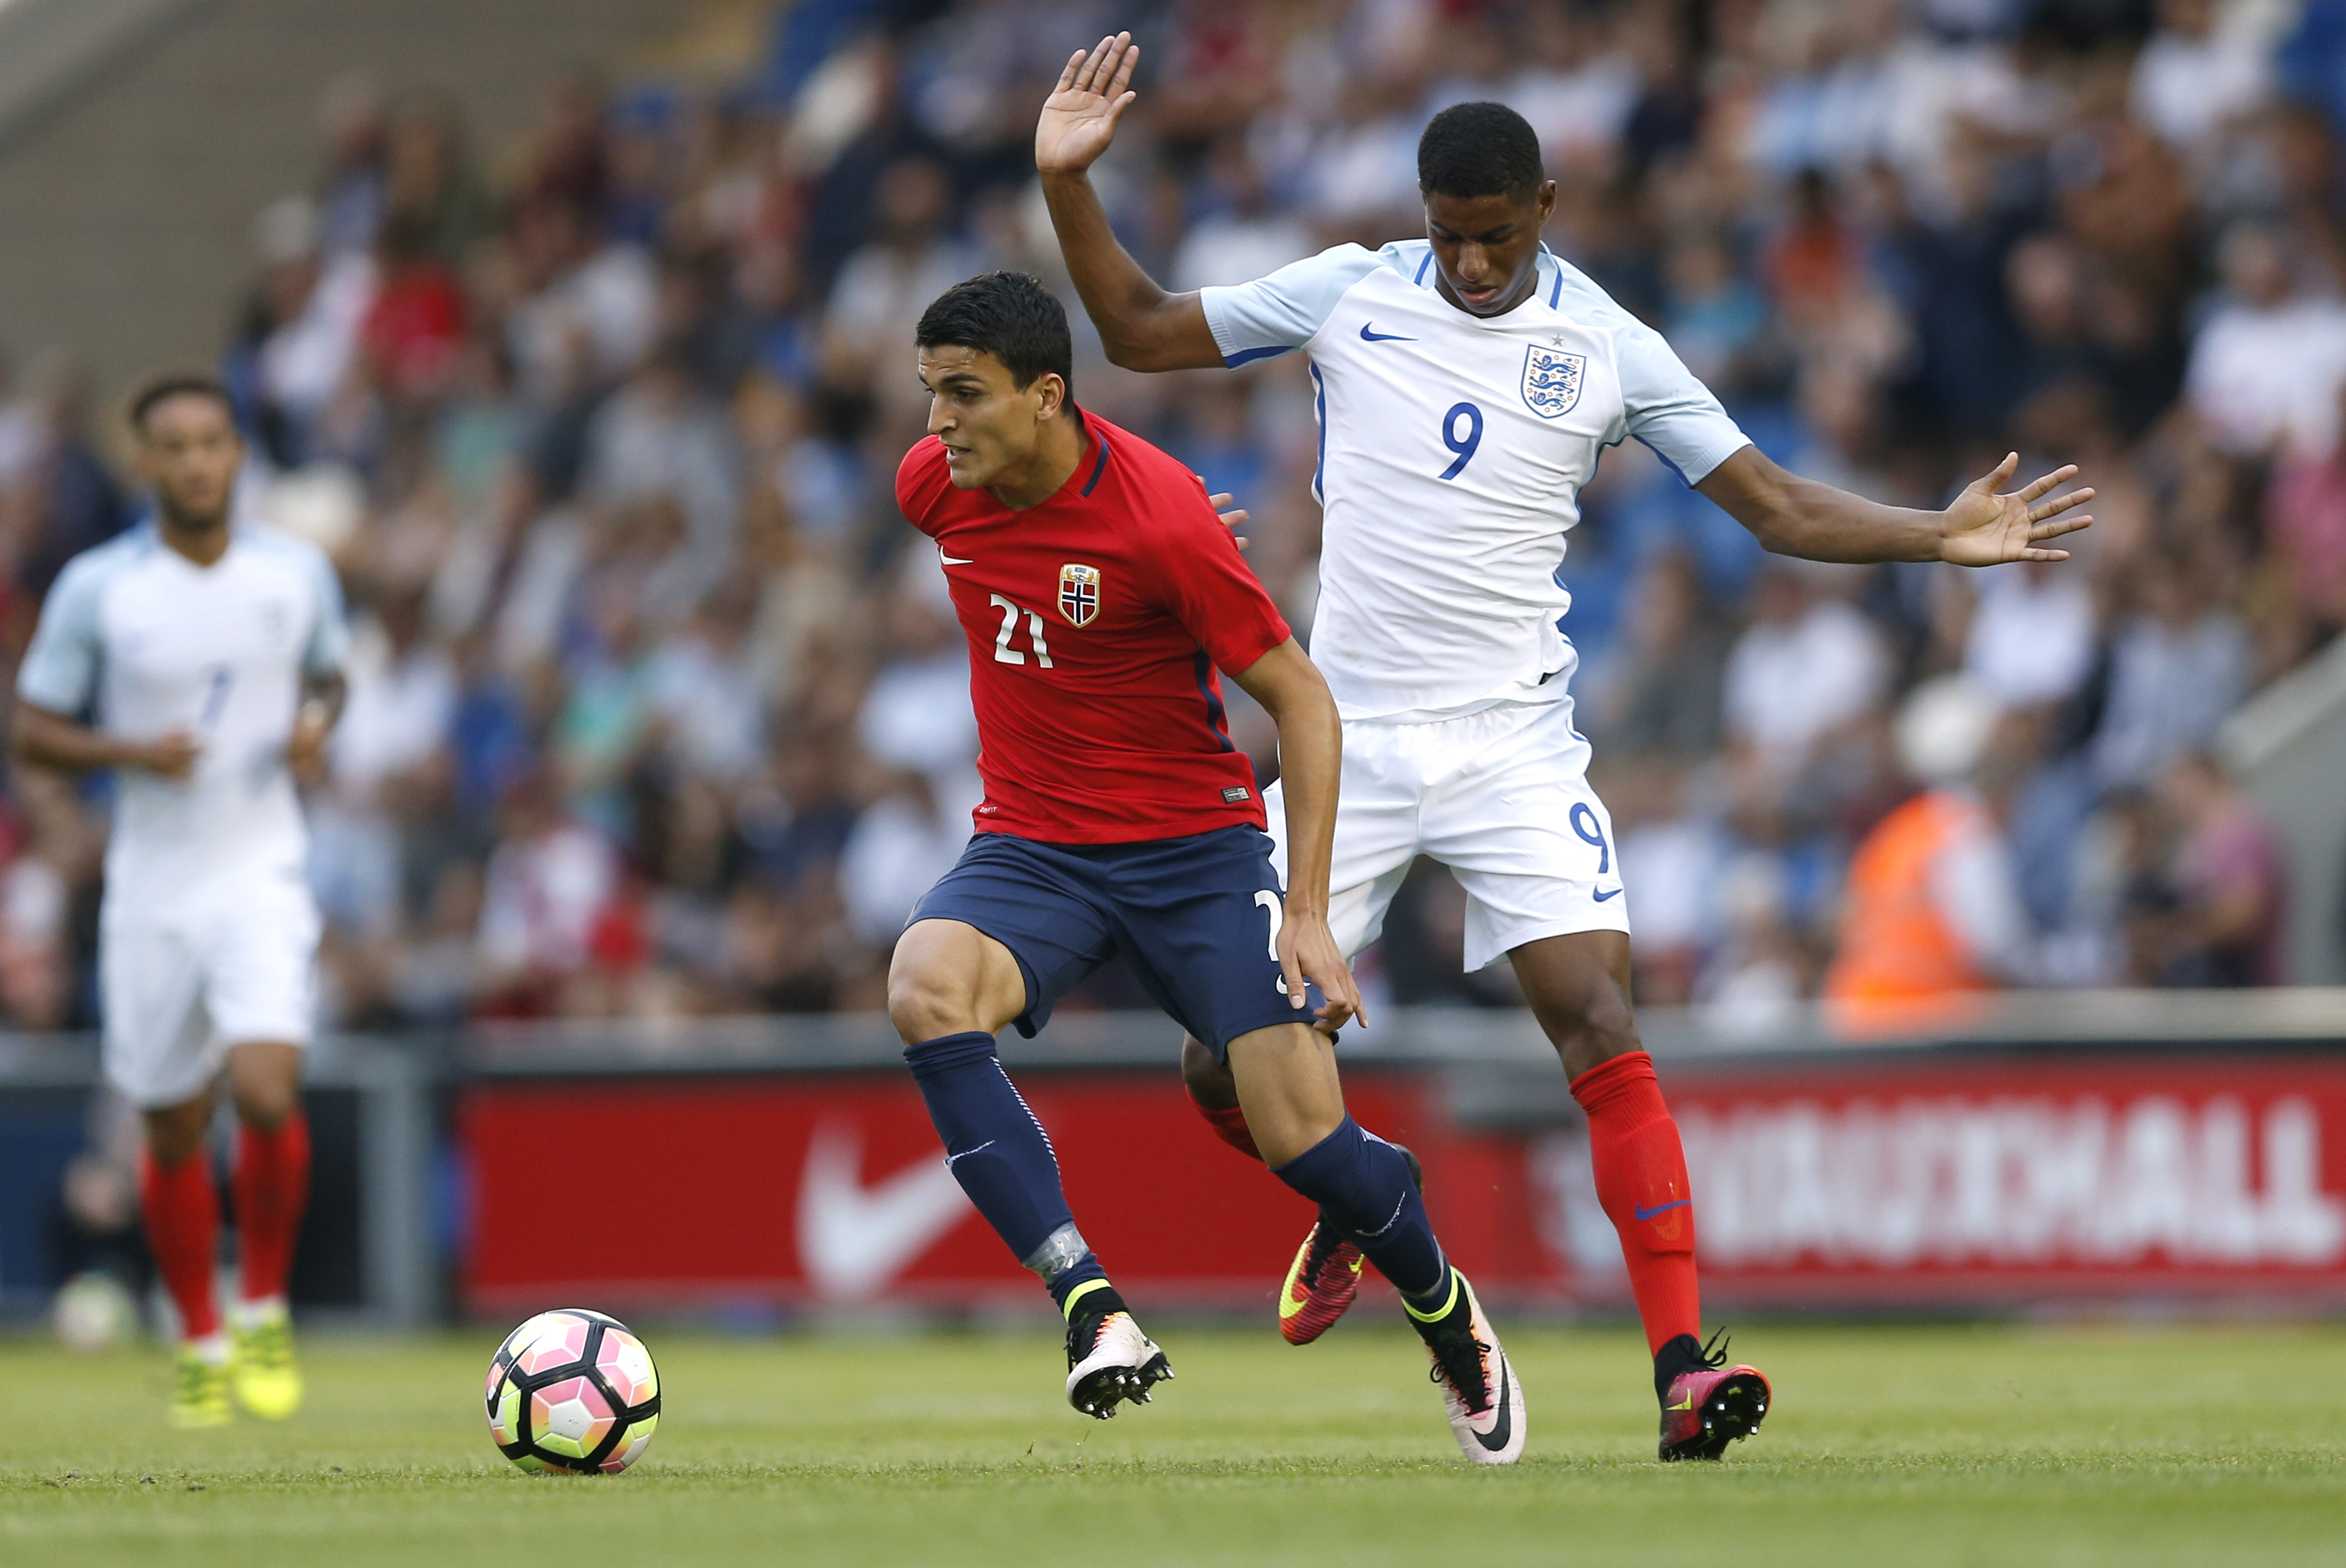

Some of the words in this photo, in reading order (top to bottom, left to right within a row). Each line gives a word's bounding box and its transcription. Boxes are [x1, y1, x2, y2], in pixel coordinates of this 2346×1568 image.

[1438, 401, 1483, 481] 9
[990, 593, 1054, 668] 21
[1569, 802, 1609, 874] 9
[1683, 1096, 2343, 1267] VAUXHALL
